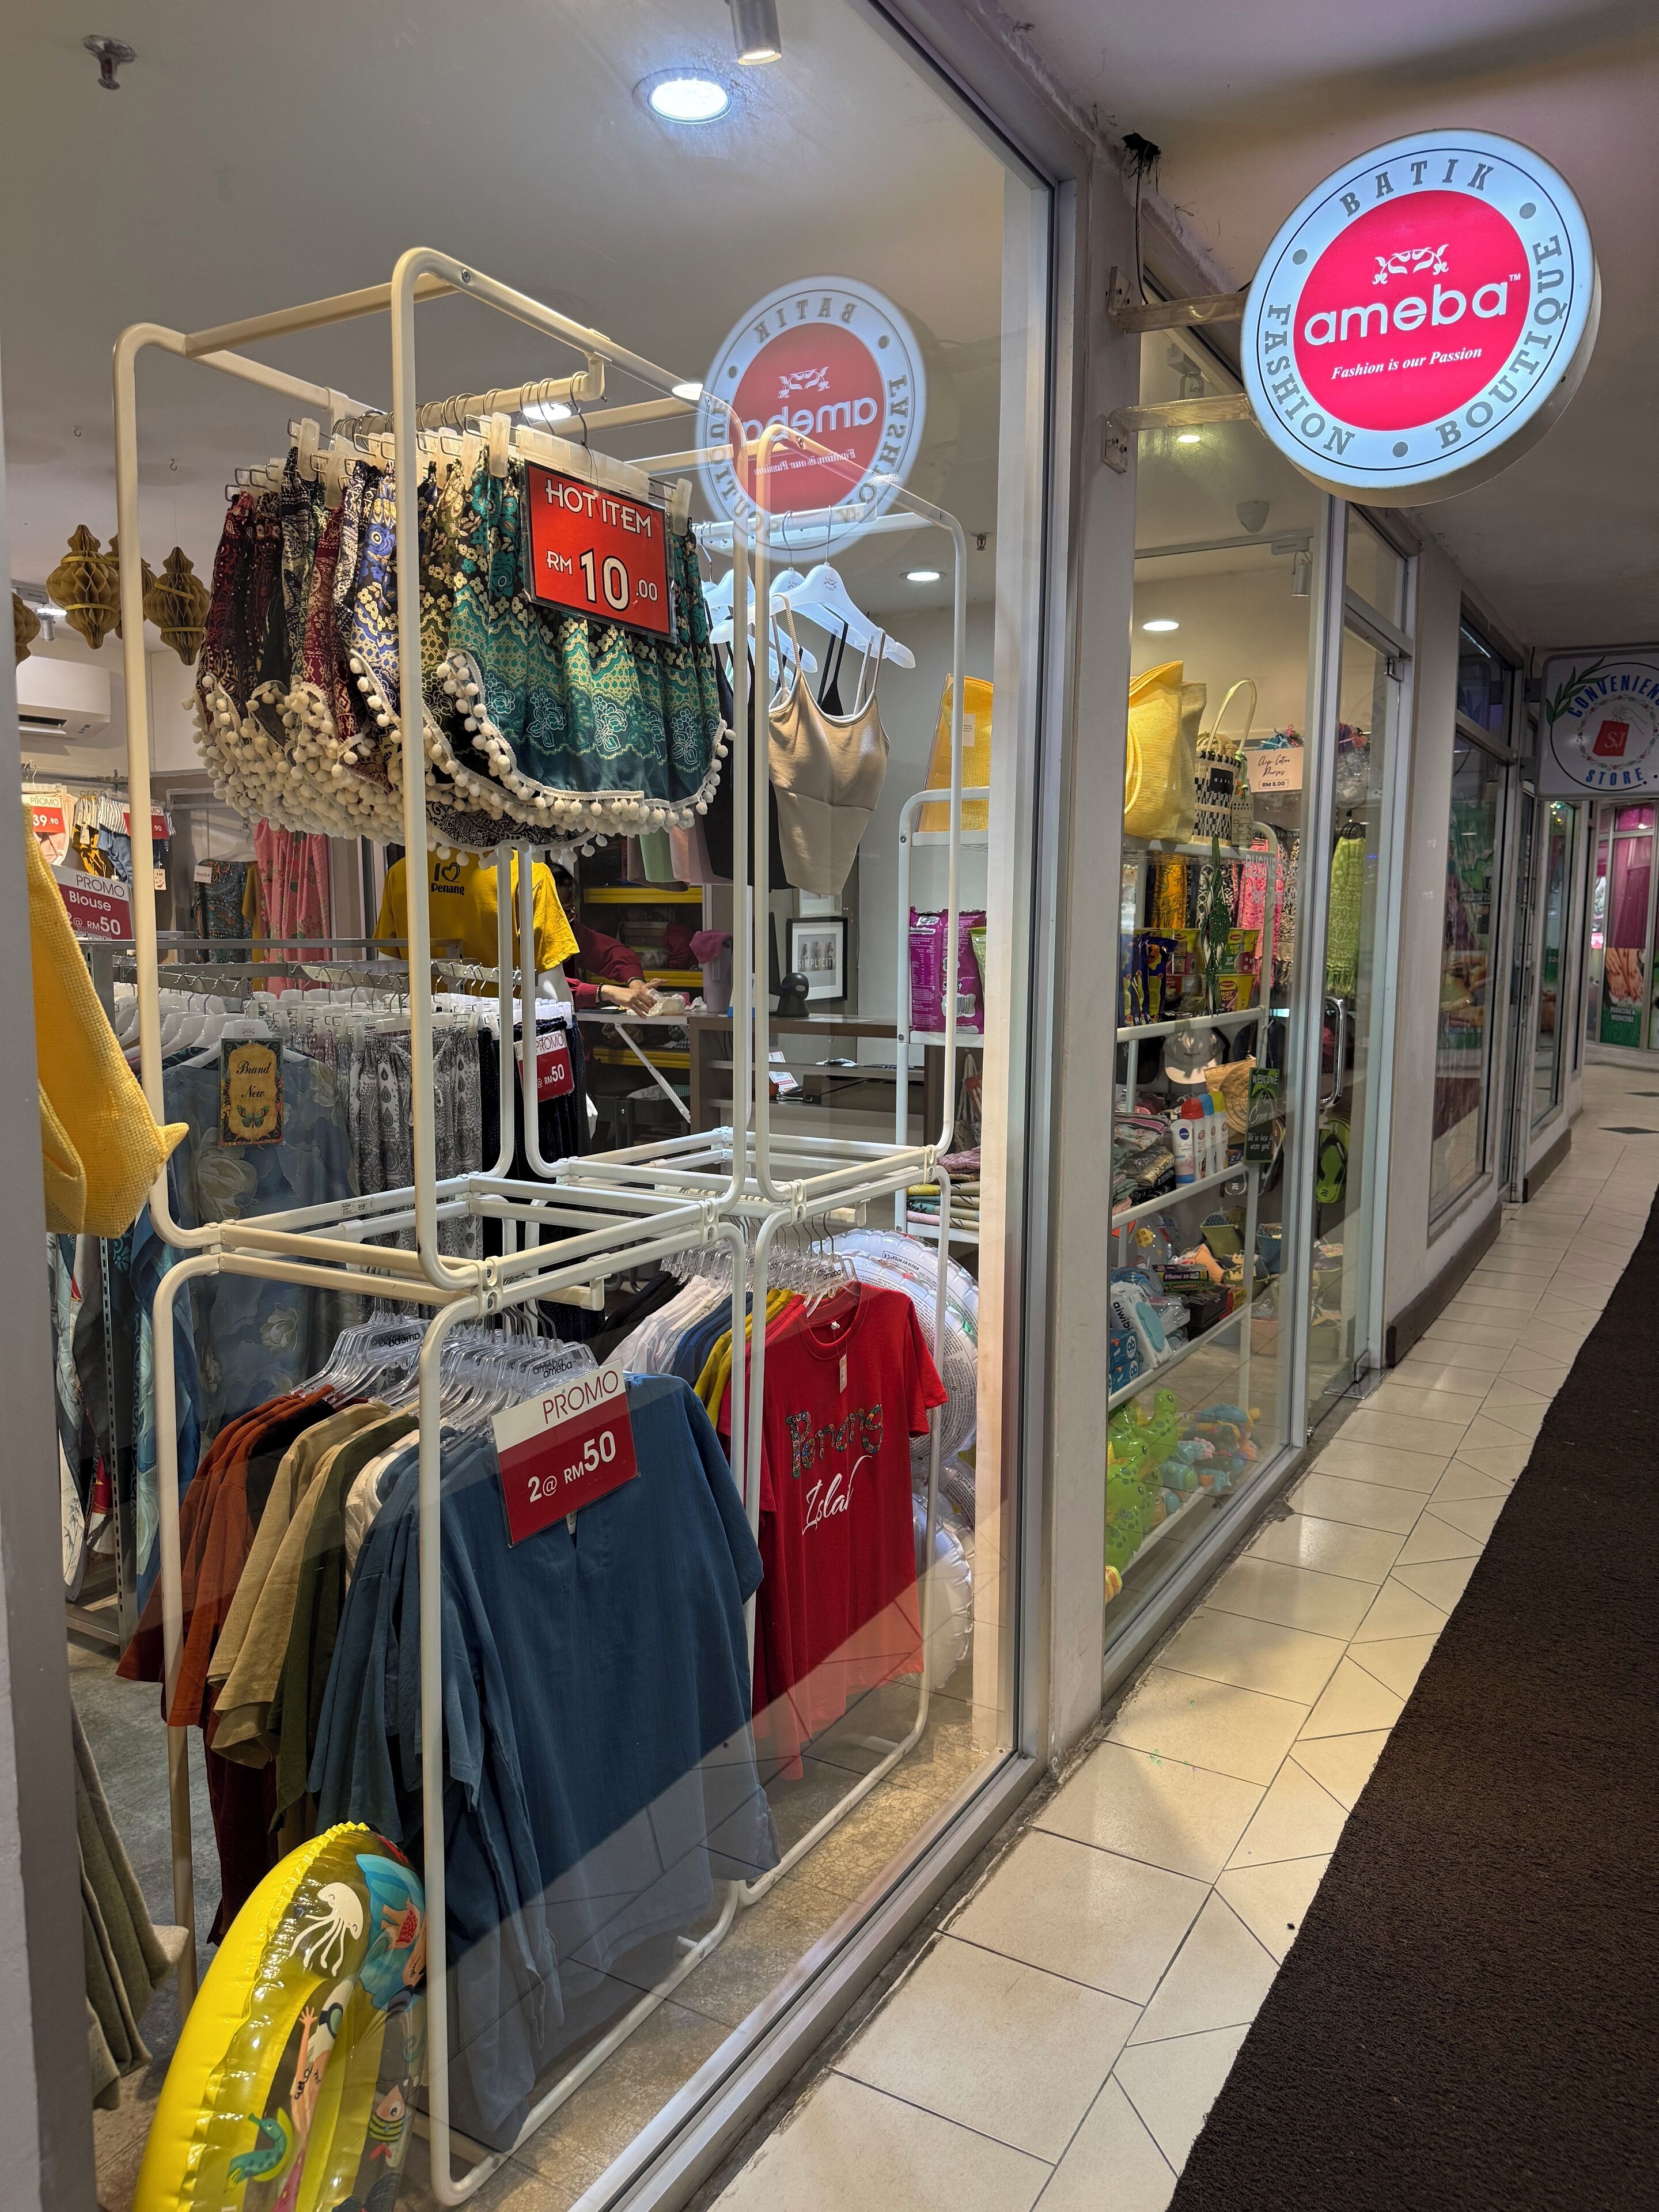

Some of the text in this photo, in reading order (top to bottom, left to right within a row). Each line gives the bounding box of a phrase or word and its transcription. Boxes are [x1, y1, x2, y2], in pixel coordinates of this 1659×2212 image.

[1339, 159, 1494, 218] BATIK
[1304, 281, 1508, 346] ameba
[1434, 234, 1569, 449] BOUTIQUE
[1331, 347, 1483, 380] Fashion is our Passion
[1264, 304, 1355, 456] FASHION
[546, 478, 652, 538] HOT ITEM
[546, 549, 573, 575] RM
[1567, 675, 1659, 718] CONVENIEN
[1586, 767, 1643, 786] STORE
[31, 797, 59, 806] PROMO
[76, 874, 125, 897] PROMO
[431, 882, 465, 896] Penang
[69, 890, 112, 912] Blouse
[798, 957, 836, 968] SIMPLICITY
[536, 1034, 565, 1053] PROMO
[236, 1060, 272, 1075] Brand
[241, 1084, 266, 1098] New
[823, 1269, 841, 1280] ameba
[1113, 1301, 1134, 1331] aiwibi
[543, 1360, 572, 1378] ameba
[542, 1370, 619, 1424] PROMO
[563, 1431, 616, 1484] RM50
